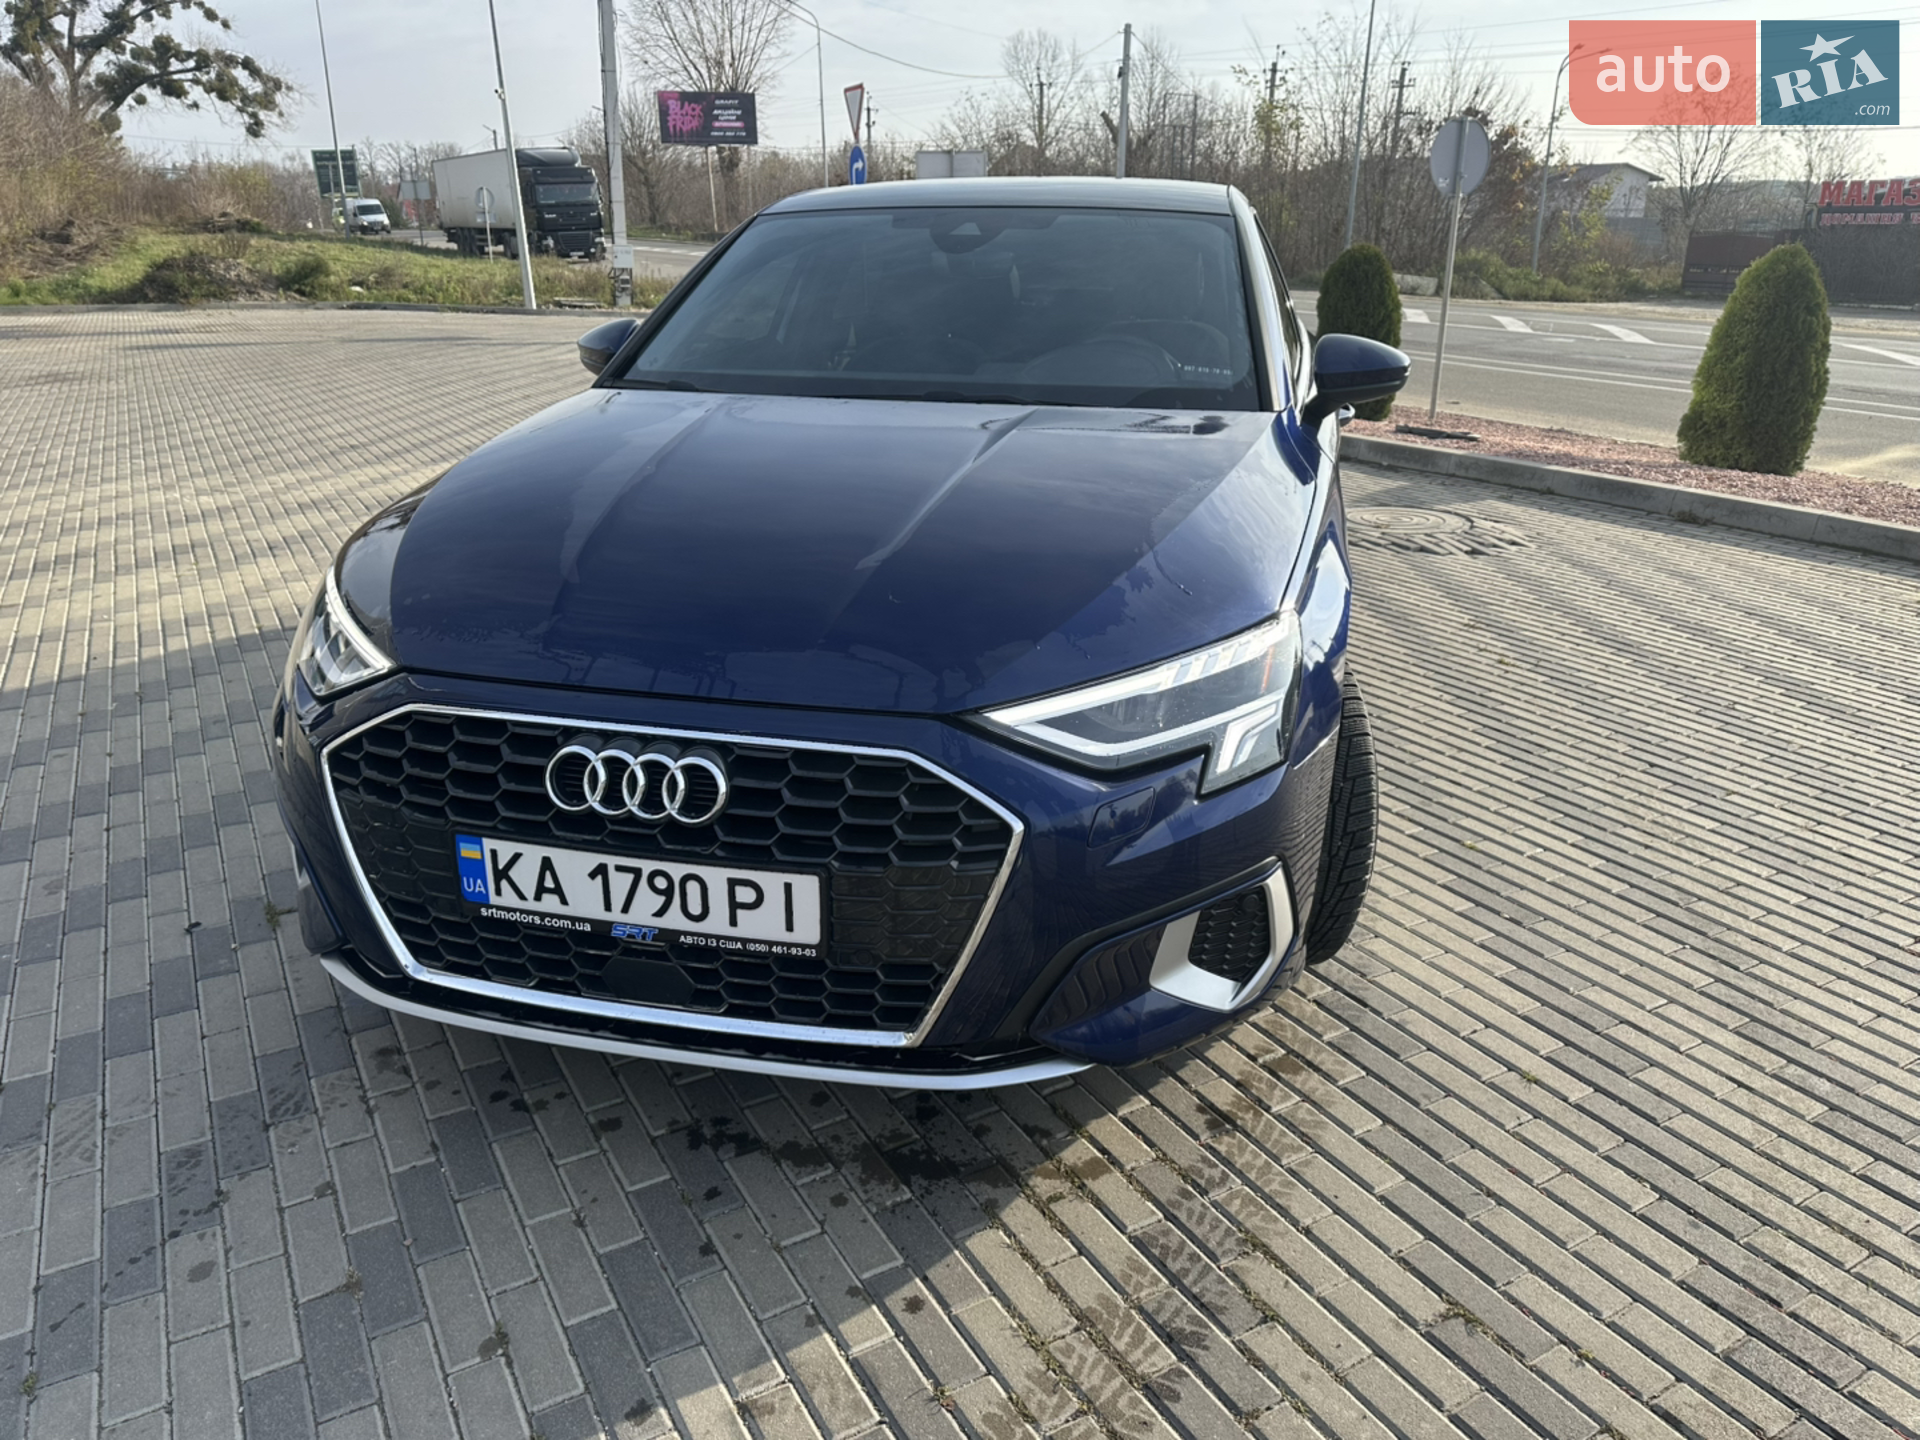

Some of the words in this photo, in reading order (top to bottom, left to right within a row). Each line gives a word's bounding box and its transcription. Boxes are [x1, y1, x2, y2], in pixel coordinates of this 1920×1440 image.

[667, 99, 703, 116] BLACK
[667, 113, 705, 132] FRIDAY
[1818, 178, 1920, 206] МАГАЗ
[463, 876, 486, 895] UA
[489, 847, 569, 907] KA
[587, 861, 710, 922] 1790
[480, 906, 592, 932] srtmotors.com.ua
[610, 923, 659, 942] SRT
[679, 934, 706, 946] АВТО
[719, 938, 743, 950] США
[746, 941, 769, 953] (050)
[771, 944, 817, 957] 461-93-03
